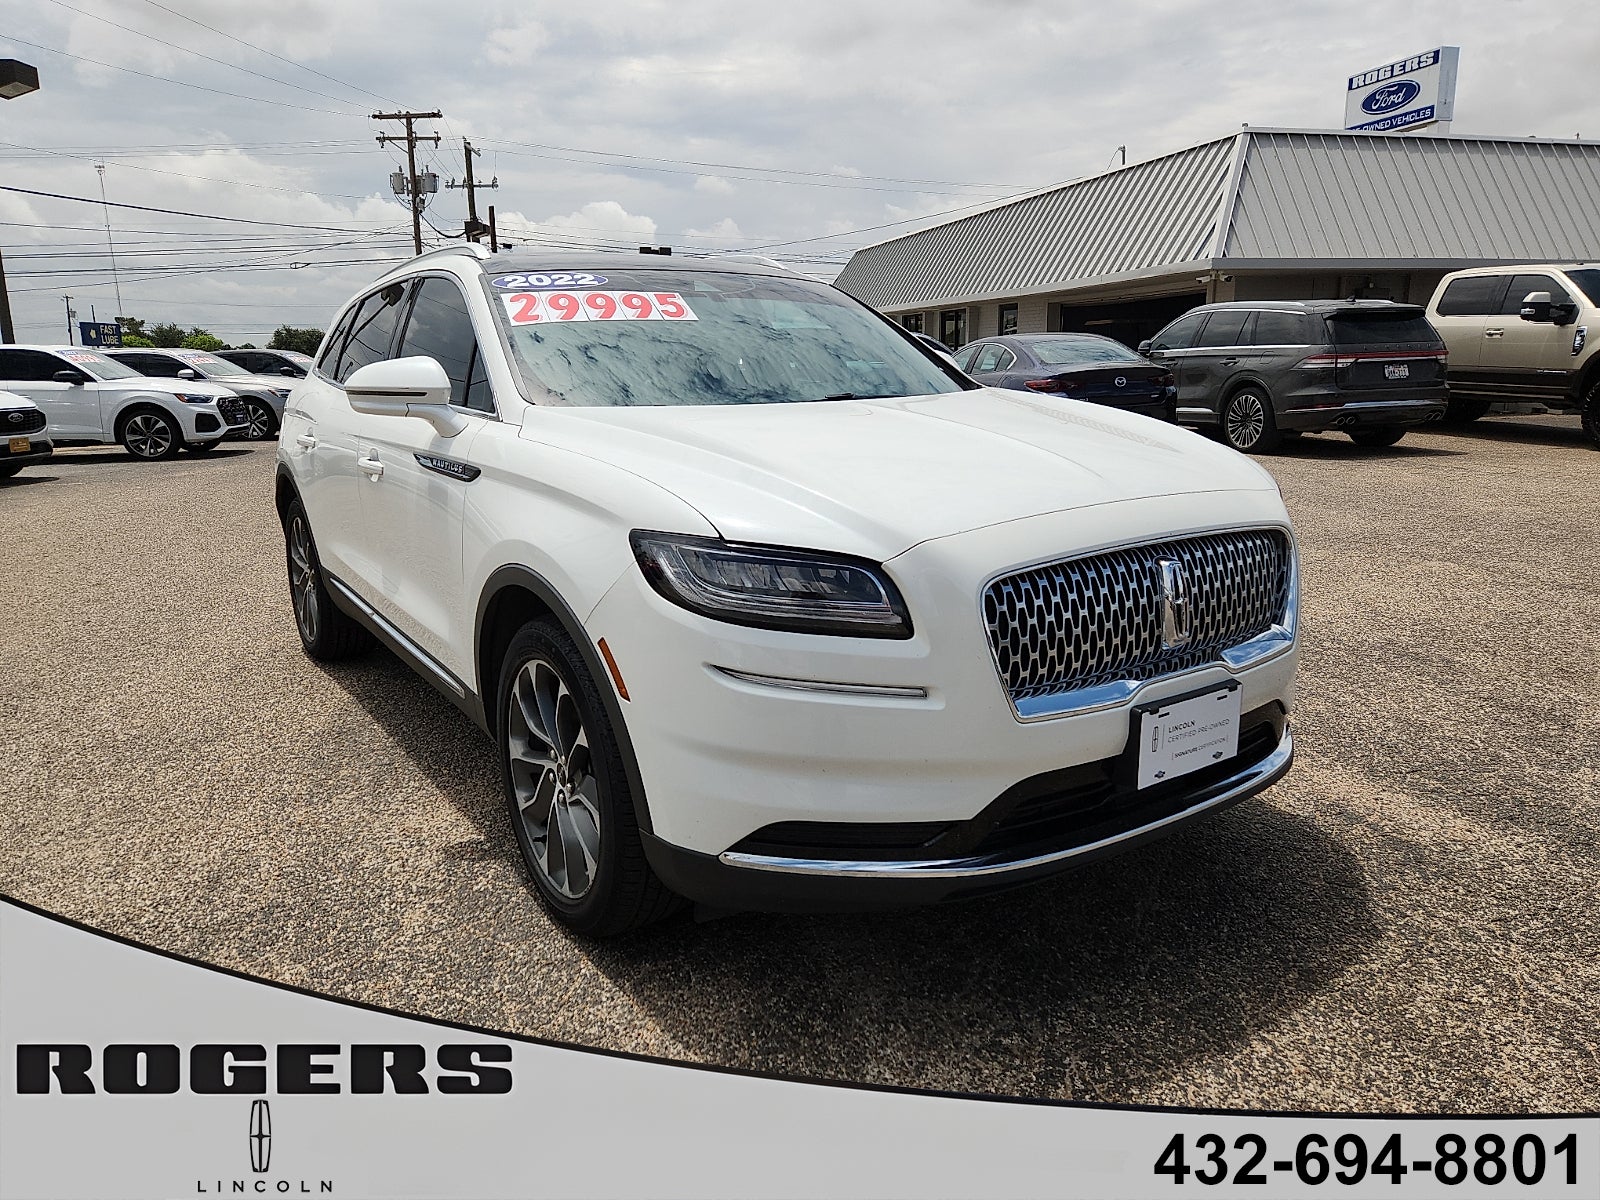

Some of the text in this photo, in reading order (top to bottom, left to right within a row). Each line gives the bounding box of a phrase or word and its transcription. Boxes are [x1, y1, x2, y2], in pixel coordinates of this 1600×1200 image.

[1352, 52, 1434, 90] ROGERS
[1371, 85, 1405, 110] Ford
[1392, 108, 1431, 126] VEHICLES
[504, 273, 598, 288] 2022
[509, 293, 689, 323] 29995
[100, 325, 116, 334] FAST
[101, 335, 119, 344] LUBE
[432, 458, 463, 474] NAUTILUS
[1168, 719, 1195, 734] LINCOLN
[1168, 718, 1230, 743] CERTIFIED PRE-OWNED
